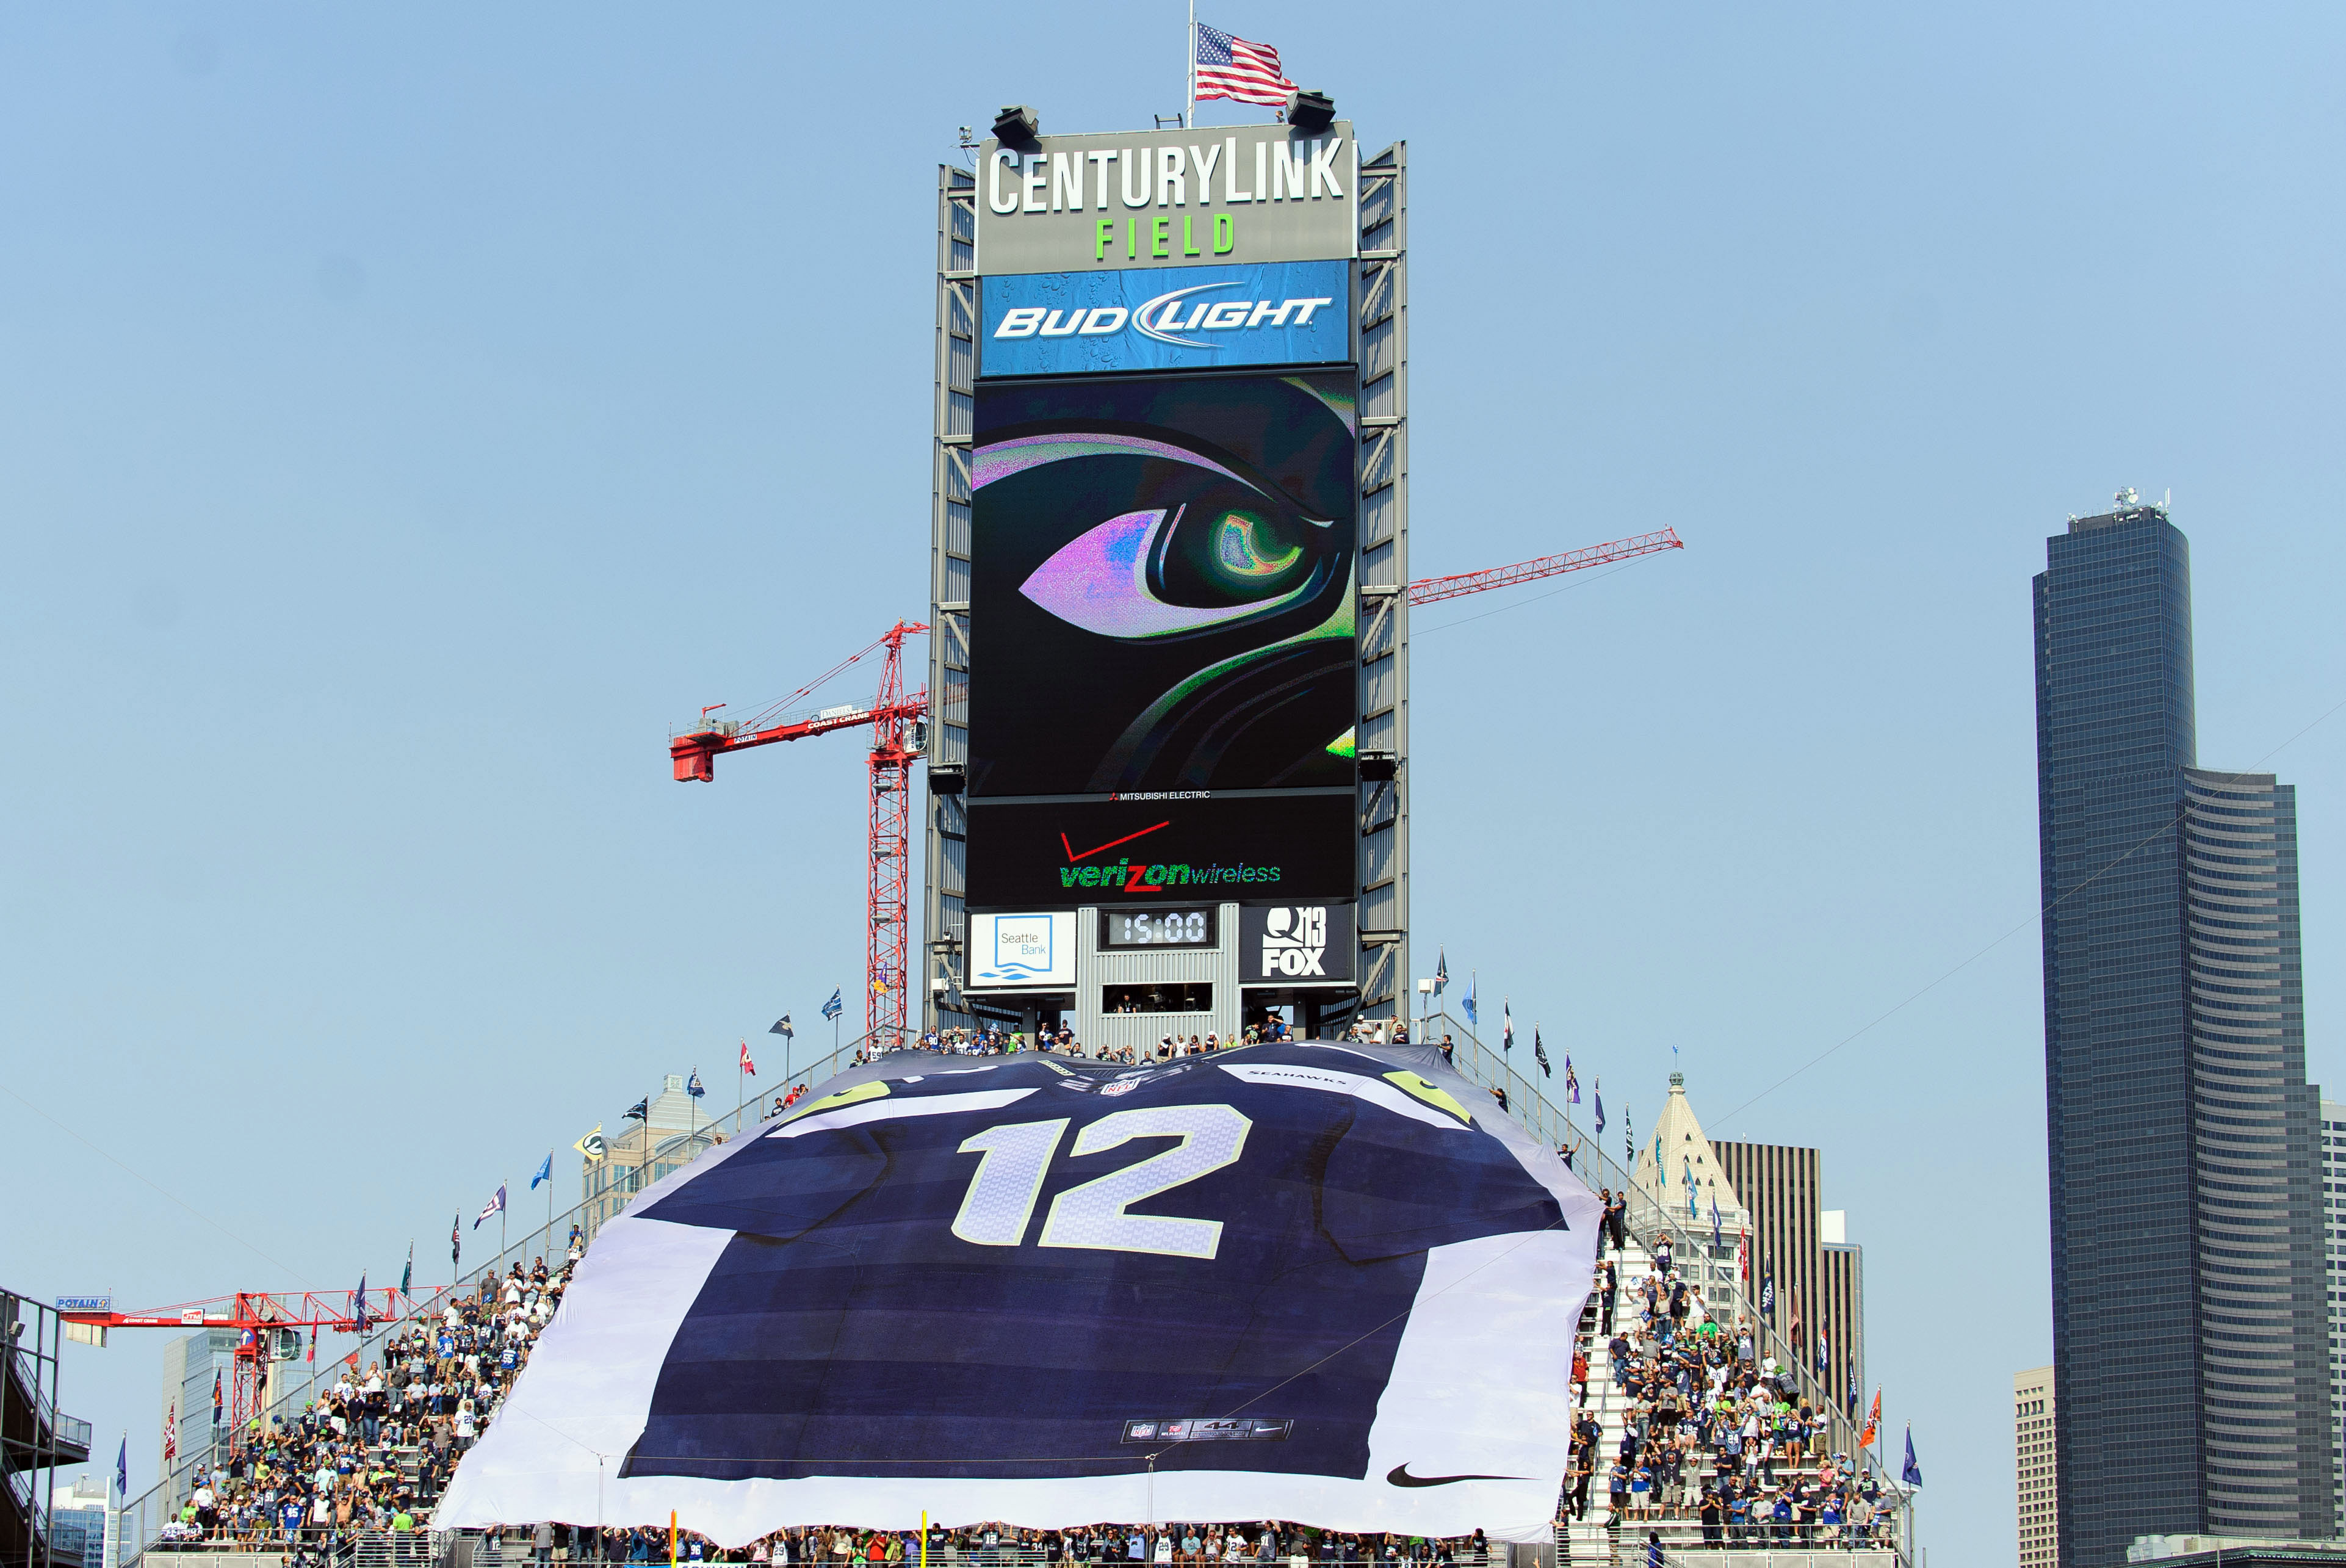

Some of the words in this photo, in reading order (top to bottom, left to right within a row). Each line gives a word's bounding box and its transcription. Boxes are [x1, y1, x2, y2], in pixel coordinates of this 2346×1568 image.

[1096, 214, 1235, 259] FIELD
[993, 307, 1128, 338] BUD
[1154, 297, 1333, 331] LIGHT
[807, 719, 837, 729] COAST
[840, 712, 870, 723] CRANE
[735, 734, 757, 743] POTAIN
[1120, 792, 1168, 801] MITSUBISHI
[1060, 858, 1191, 892] verizon
[1190, 862, 1282, 885] wireless
[1124, 911, 1205, 944] 15:00
[1001, 932, 1038, 944] Seattle
[1022, 944, 1046, 955] Bank
[1262, 948, 1326, 977] FOX
[1247, 1069, 1347, 1085] SEAHAWKS
[1107, 1083, 1131, 1093] NFL
[951, 1104, 1253, 1260] 12
[58, 1299, 98, 1308] POTAIN
[464, 1415, 472, 1424] 29
[1727, 1434, 1739, 1444] 24
[265, 1492, 274, 1502] 51
[287, 1508, 298, 1518] 45
[986, 1534, 997, 1544] 12
[691, 1545, 701, 1555] 96
[774, 1547, 784, 1556] 29
